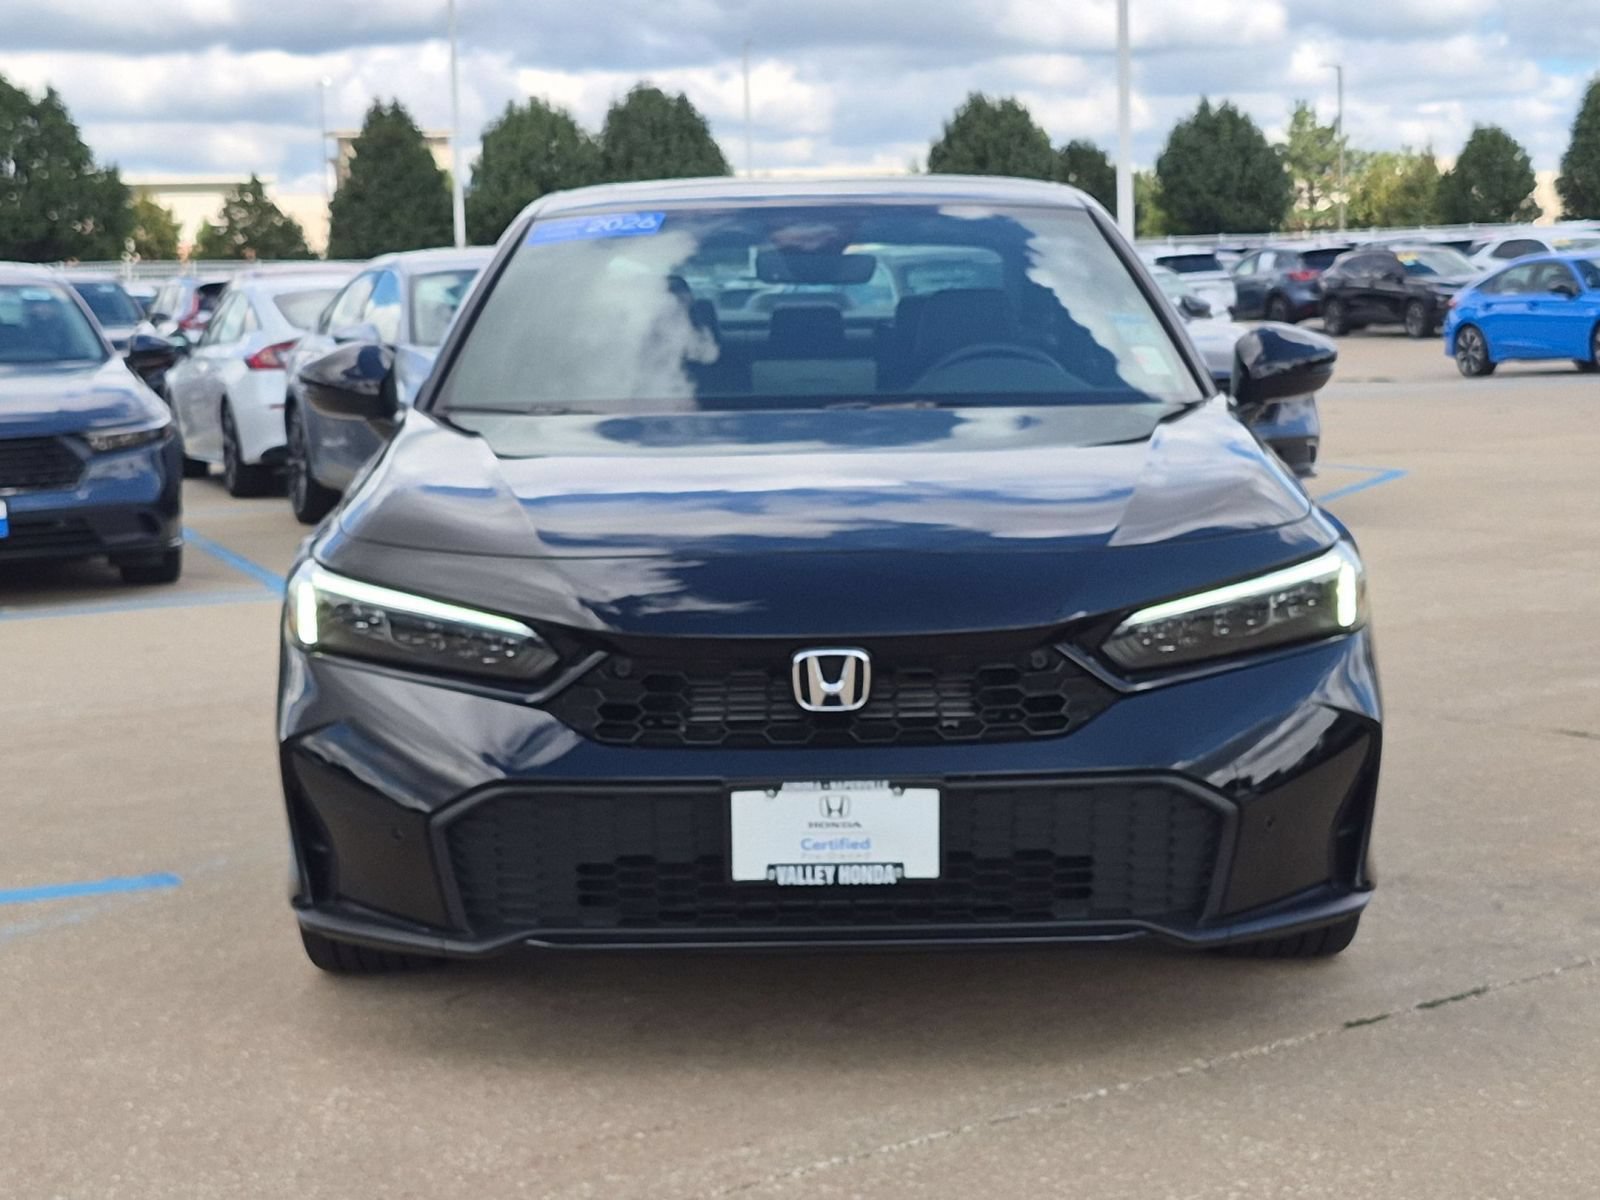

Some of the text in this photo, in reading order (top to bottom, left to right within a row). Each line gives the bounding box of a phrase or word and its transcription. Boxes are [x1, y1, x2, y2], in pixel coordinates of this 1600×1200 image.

[585, 212, 658, 234] 2026
[807, 821, 863, 830] HONDA
[800, 836, 872, 852] Certified
[776, 864, 898, 886] VALLEY HONDA
